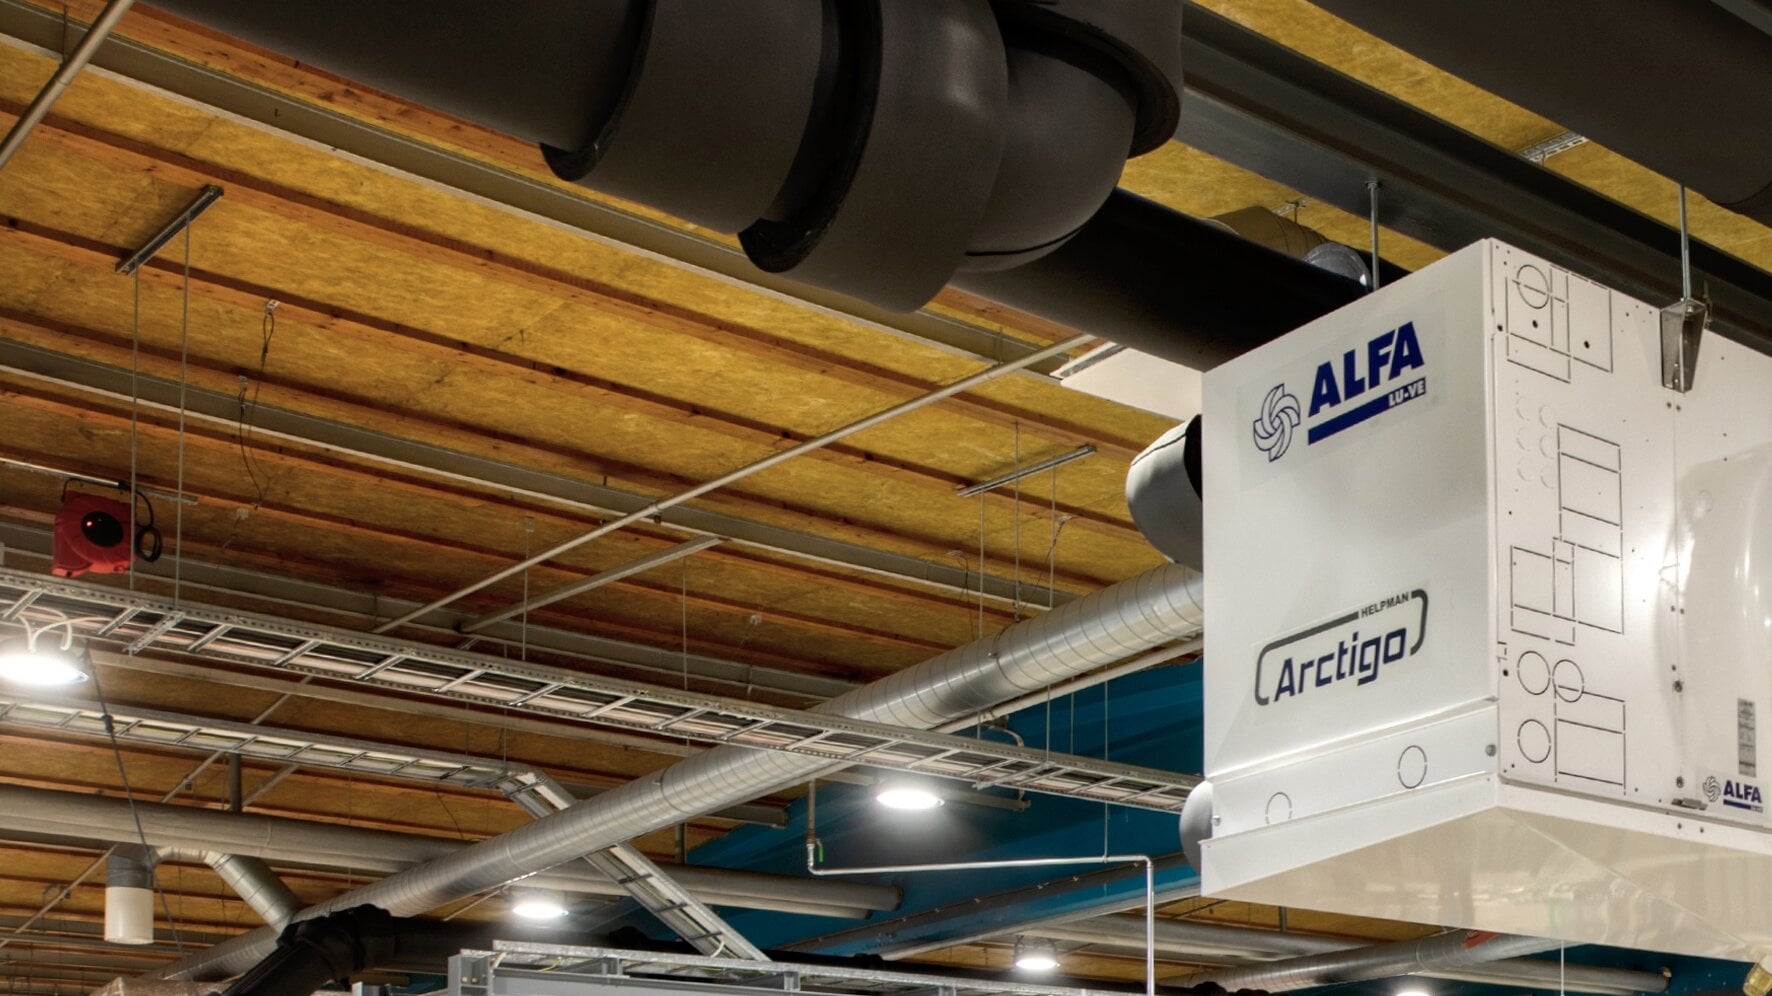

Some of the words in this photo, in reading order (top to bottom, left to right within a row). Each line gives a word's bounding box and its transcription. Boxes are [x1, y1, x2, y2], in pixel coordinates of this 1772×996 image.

[1308, 321, 1425, 418] ALFA
[1388, 377, 1426, 408] LU-VE
[1360, 591, 1410, 619] HELPMAN
[1274, 627, 1407, 703] Arctigo
[1723, 780, 1763, 804] ALFA
